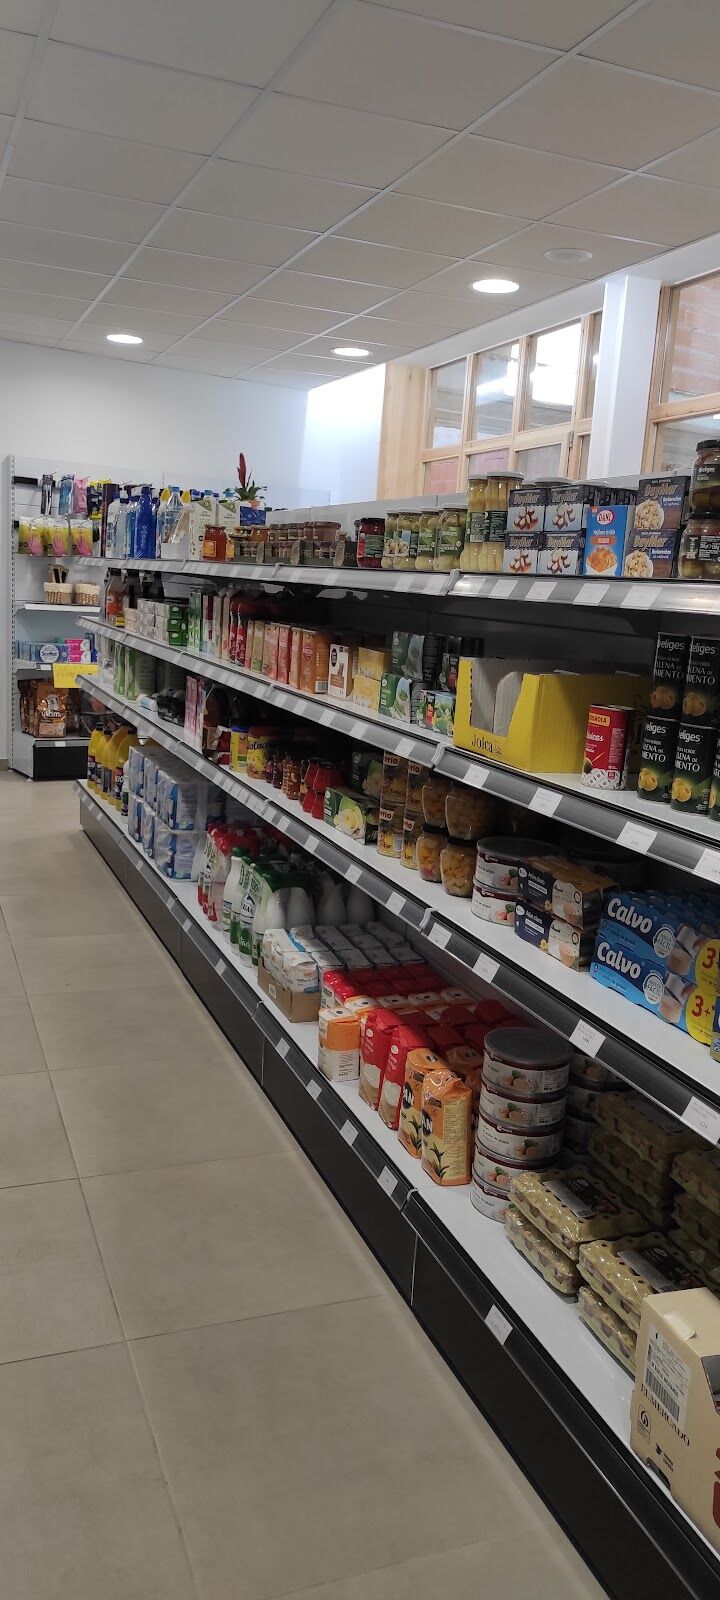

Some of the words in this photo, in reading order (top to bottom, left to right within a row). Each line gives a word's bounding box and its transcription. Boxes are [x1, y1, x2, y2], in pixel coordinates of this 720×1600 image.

[472, 734, 493, 753] Jolca
[607, 897, 653, 934] Calvo
[597, 942, 641, 979] Calvo
